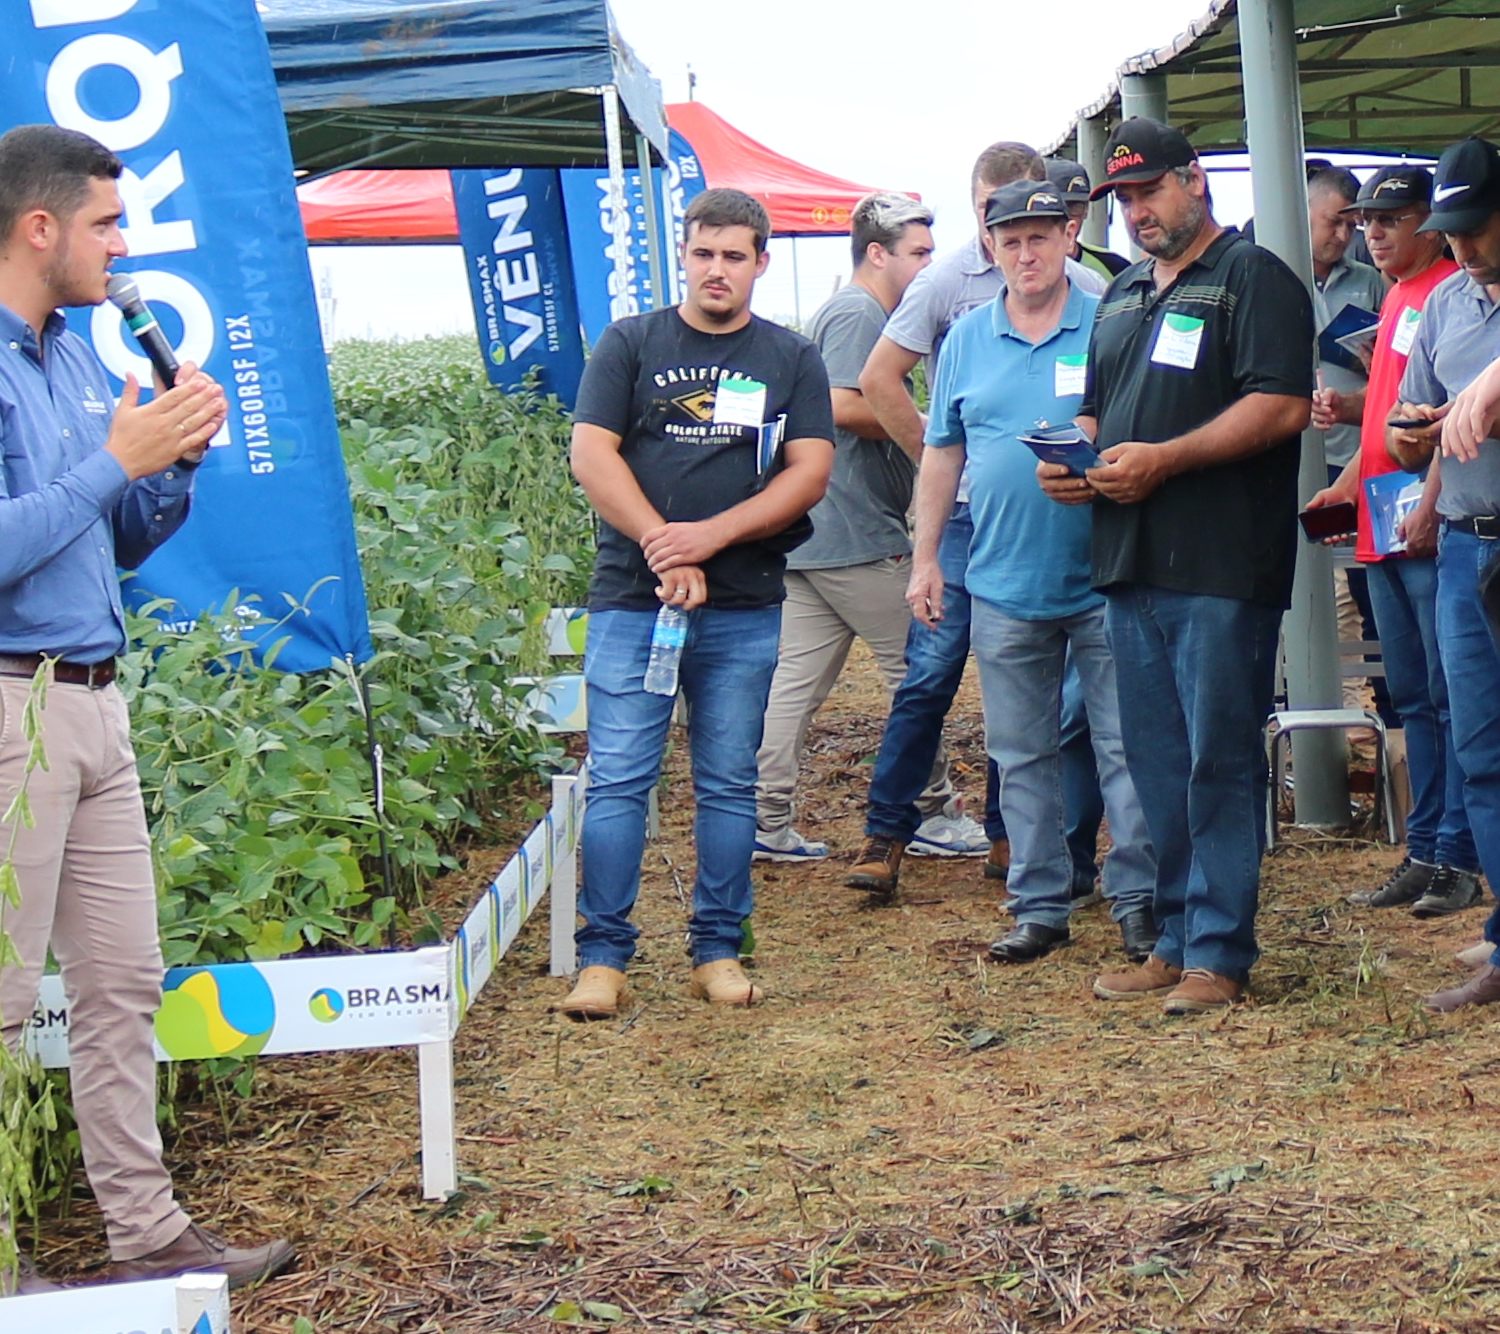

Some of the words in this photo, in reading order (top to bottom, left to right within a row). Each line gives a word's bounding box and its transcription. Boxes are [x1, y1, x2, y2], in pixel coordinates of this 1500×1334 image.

[1107, 152, 1144, 176] SENNA
[476, 254, 500, 340] BRASMAX
[664, 423, 707, 437] GOLDEN
[709, 425, 744, 436] STATE
